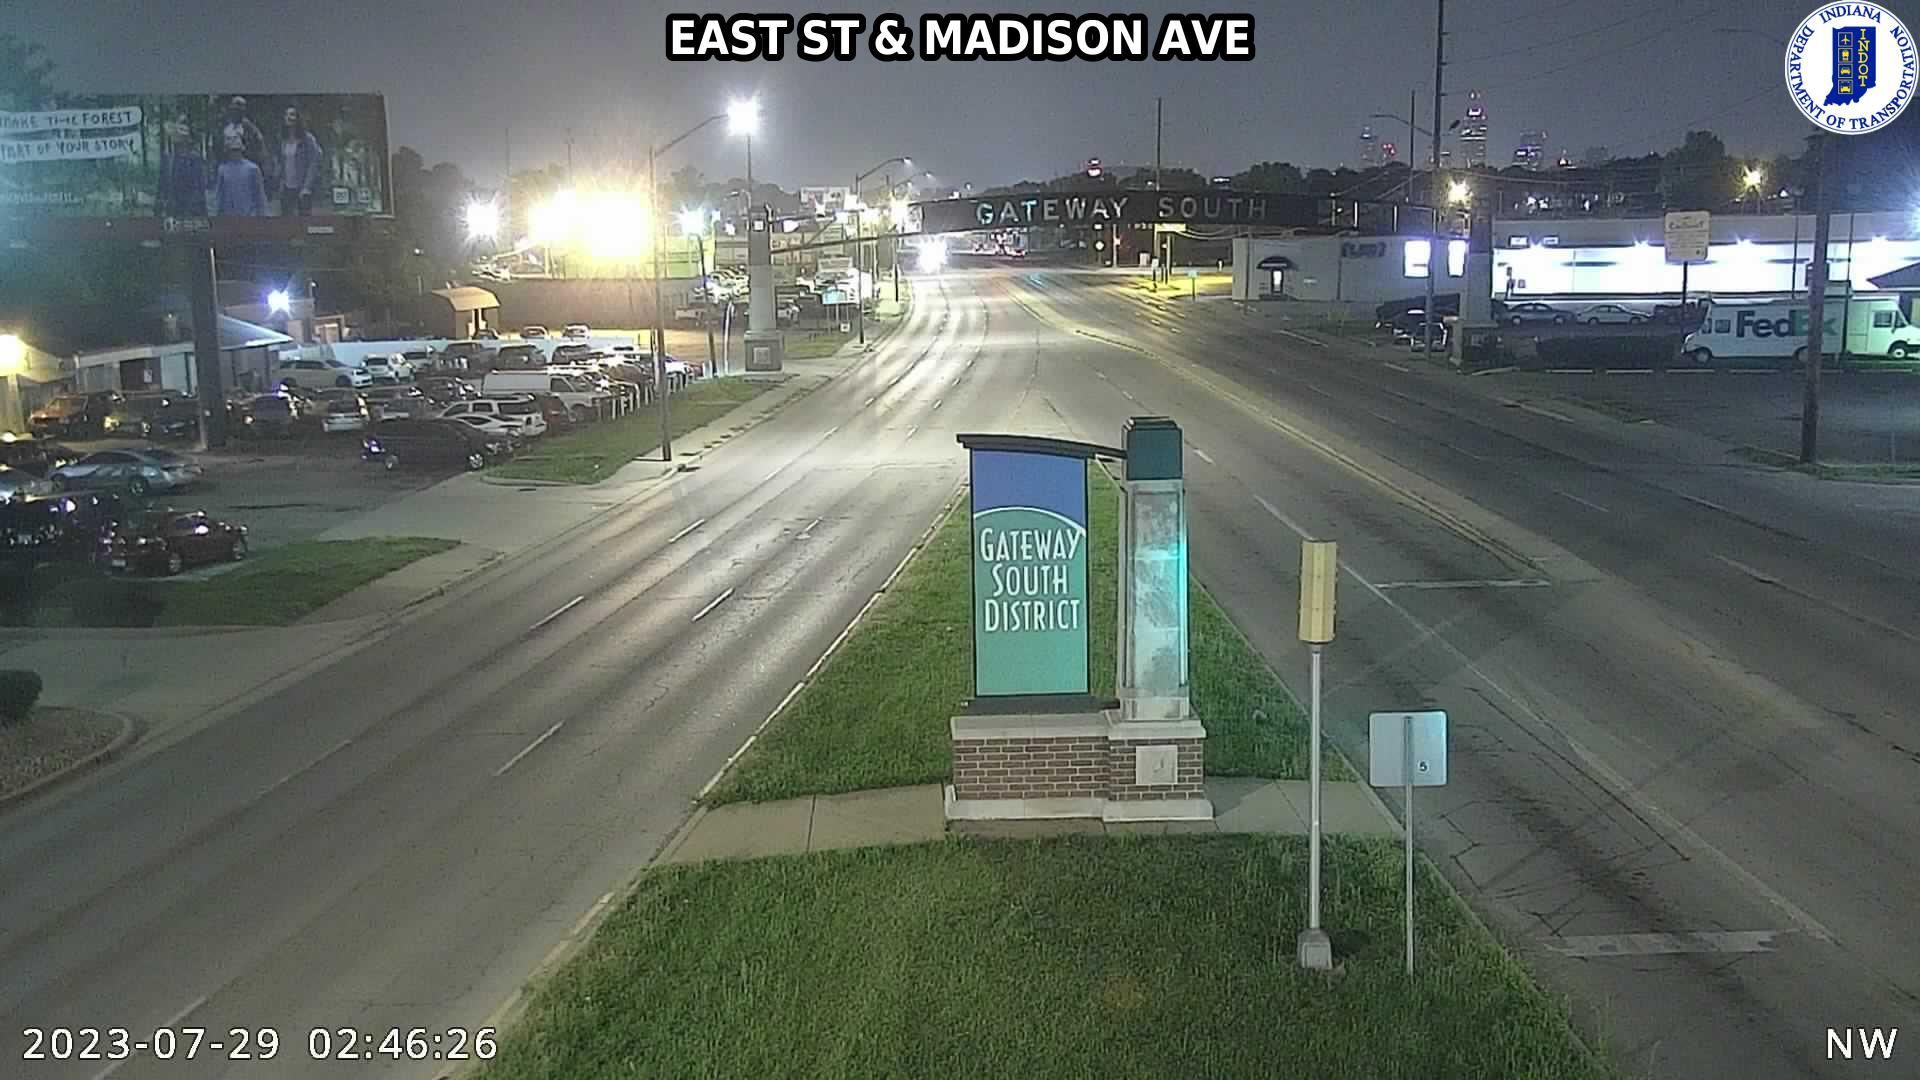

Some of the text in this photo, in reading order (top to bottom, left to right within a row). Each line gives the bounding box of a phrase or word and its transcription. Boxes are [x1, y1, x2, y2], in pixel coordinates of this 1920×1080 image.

[81, 110, 132, 126] FOREST
[95, 137, 137, 154] STORY
[975, 196, 1267, 225] GATEWAY SOUTH
[980, 527, 1082, 561] GATEWAY
[991, 562, 1068, 597] SOUTH
[984, 599, 1080, 632] DISTRICT
